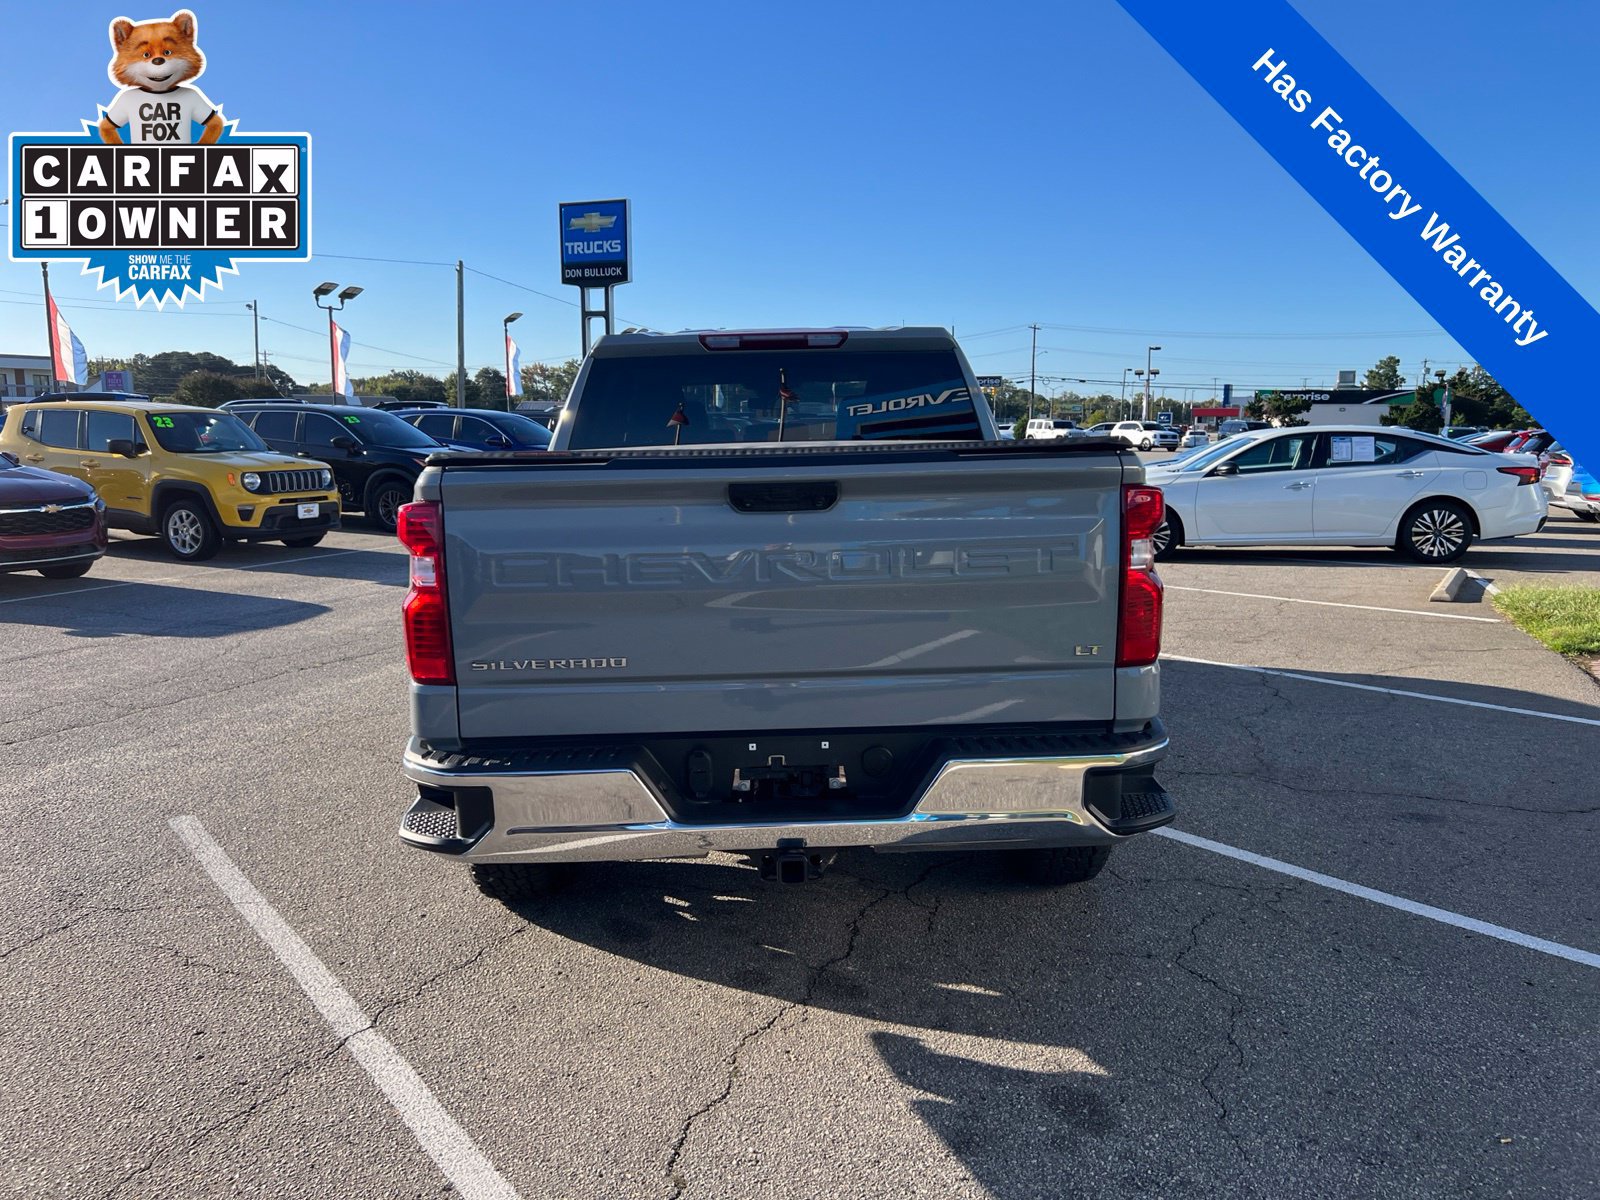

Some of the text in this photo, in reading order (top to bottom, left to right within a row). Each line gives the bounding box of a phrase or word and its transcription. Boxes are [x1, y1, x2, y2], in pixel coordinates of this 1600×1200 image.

[565, 240, 622, 255] TRUCKS
[565, 267, 623, 278] DON BULLUCK
[152, 416, 175, 428] 23
[485, 540, 1078, 589] CHEVROLET
[1075, 645, 1103, 656] LT
[471, 657, 628, 671] SILVERADO
